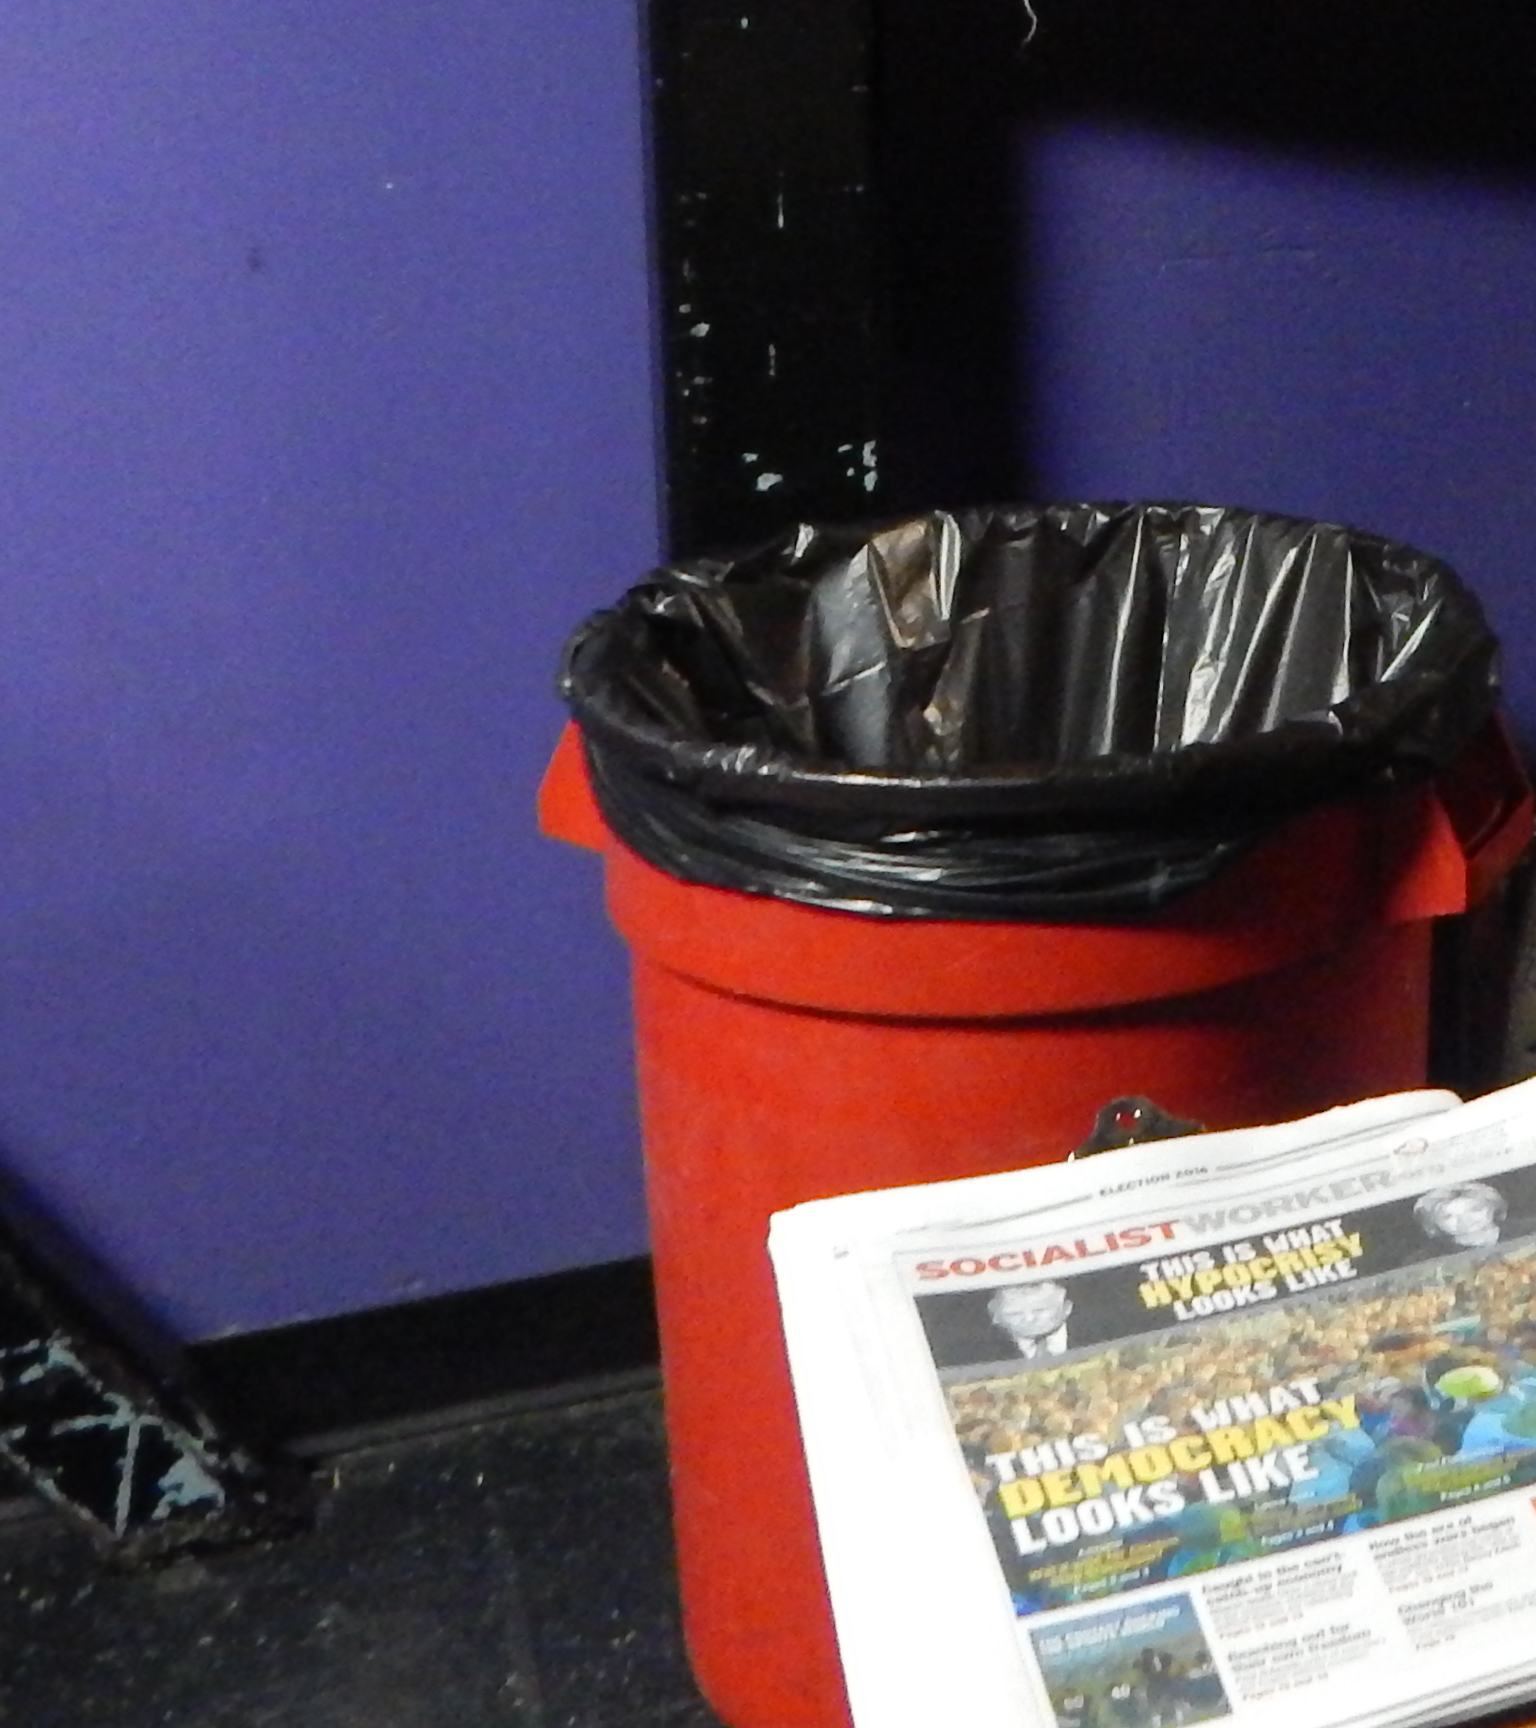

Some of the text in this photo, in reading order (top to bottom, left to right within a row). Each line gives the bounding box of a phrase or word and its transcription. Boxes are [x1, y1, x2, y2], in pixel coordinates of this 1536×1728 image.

[1099, 1172, 1172, 1197] ELECTION
[1135, 1232, 1368, 1310] HYPOCRISY
[1140, 1217, 1349, 1284] THIS IS WHAT
[1173, 1258, 1358, 1322] LOOKS LIKE
[985, 1376, 1323, 1483] THIS IS WHAT
[998, 1393, 1361, 1520] DEMOCRACY
[1011, 1478, 1186, 1557] LOOKS
[1199, 1444, 1320, 1504] LIKE
